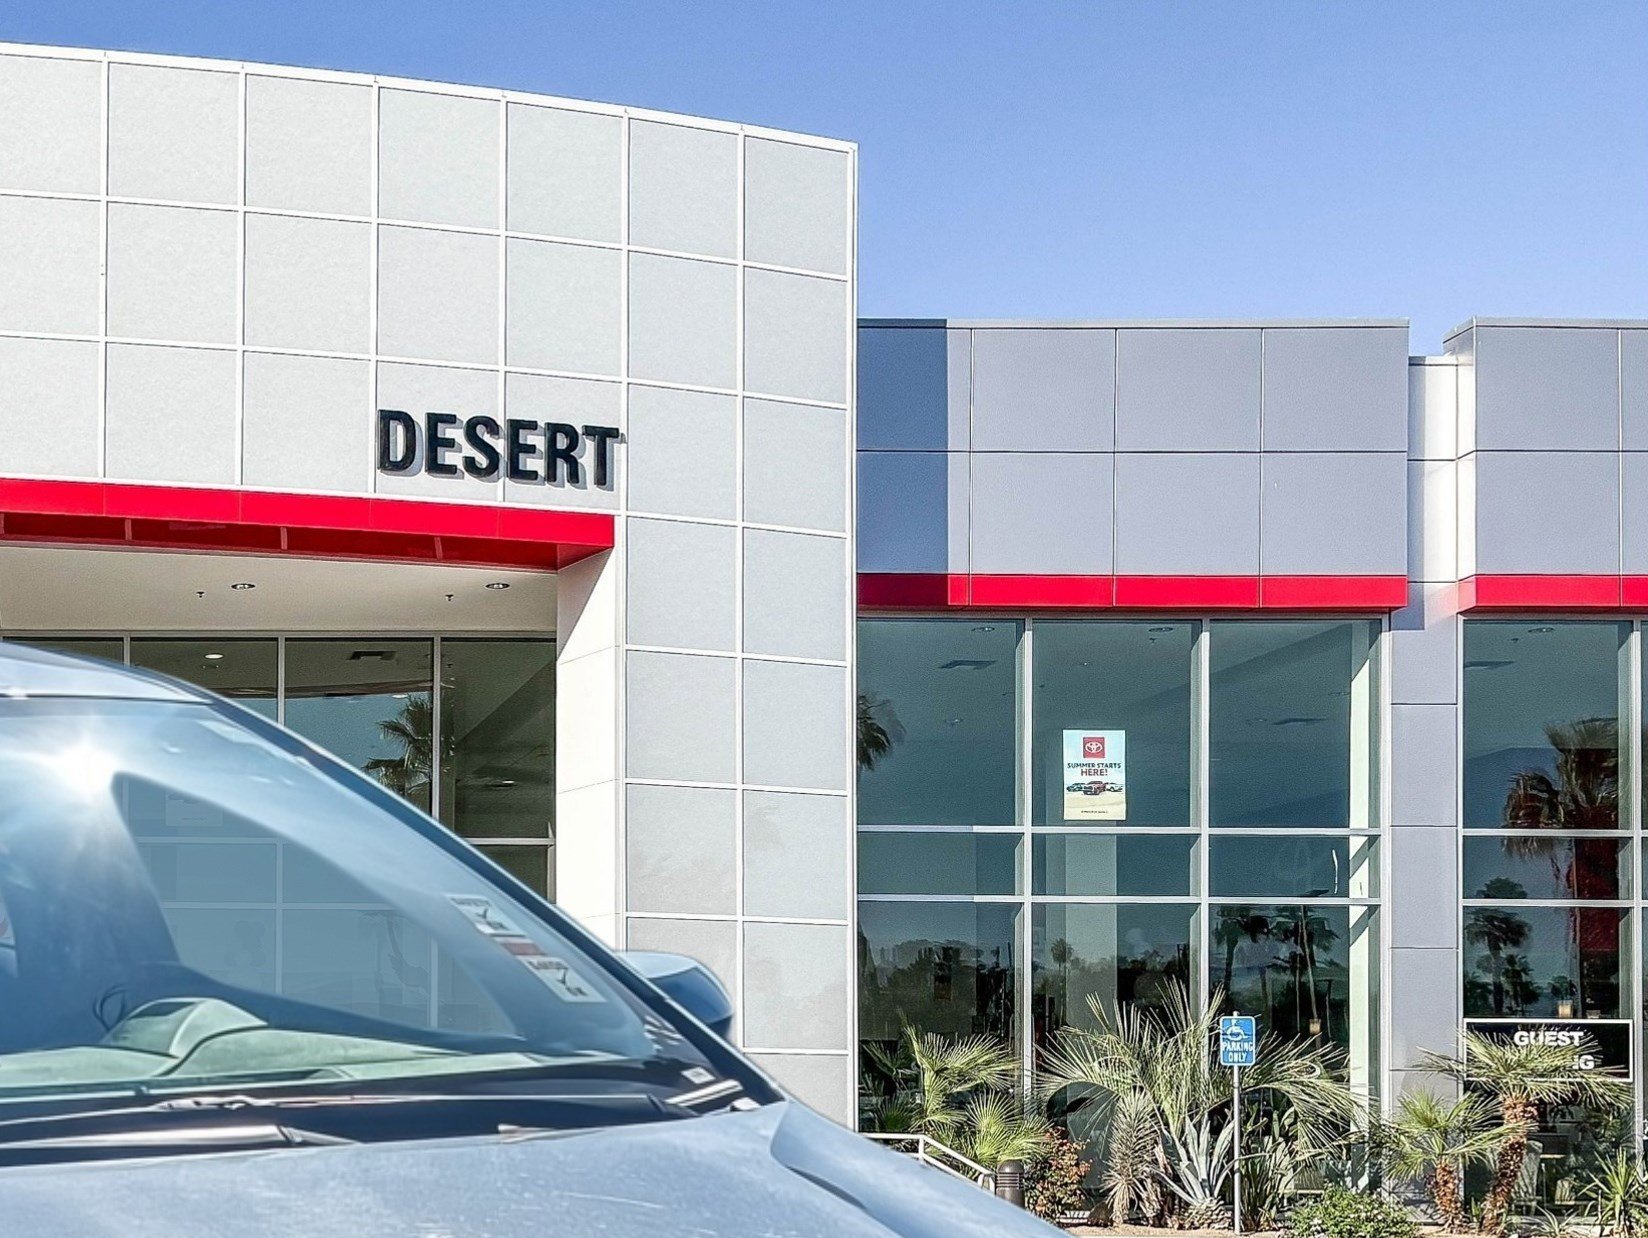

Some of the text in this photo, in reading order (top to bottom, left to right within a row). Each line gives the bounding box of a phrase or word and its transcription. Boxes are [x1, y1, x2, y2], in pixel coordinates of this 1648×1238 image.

[377, 408, 620, 487] DESERT
[1513, 1031, 1584, 1046] GUEST
[1222, 1041, 1254, 1051] PARKING
[1228, 1052, 1247, 1062] ONLY
